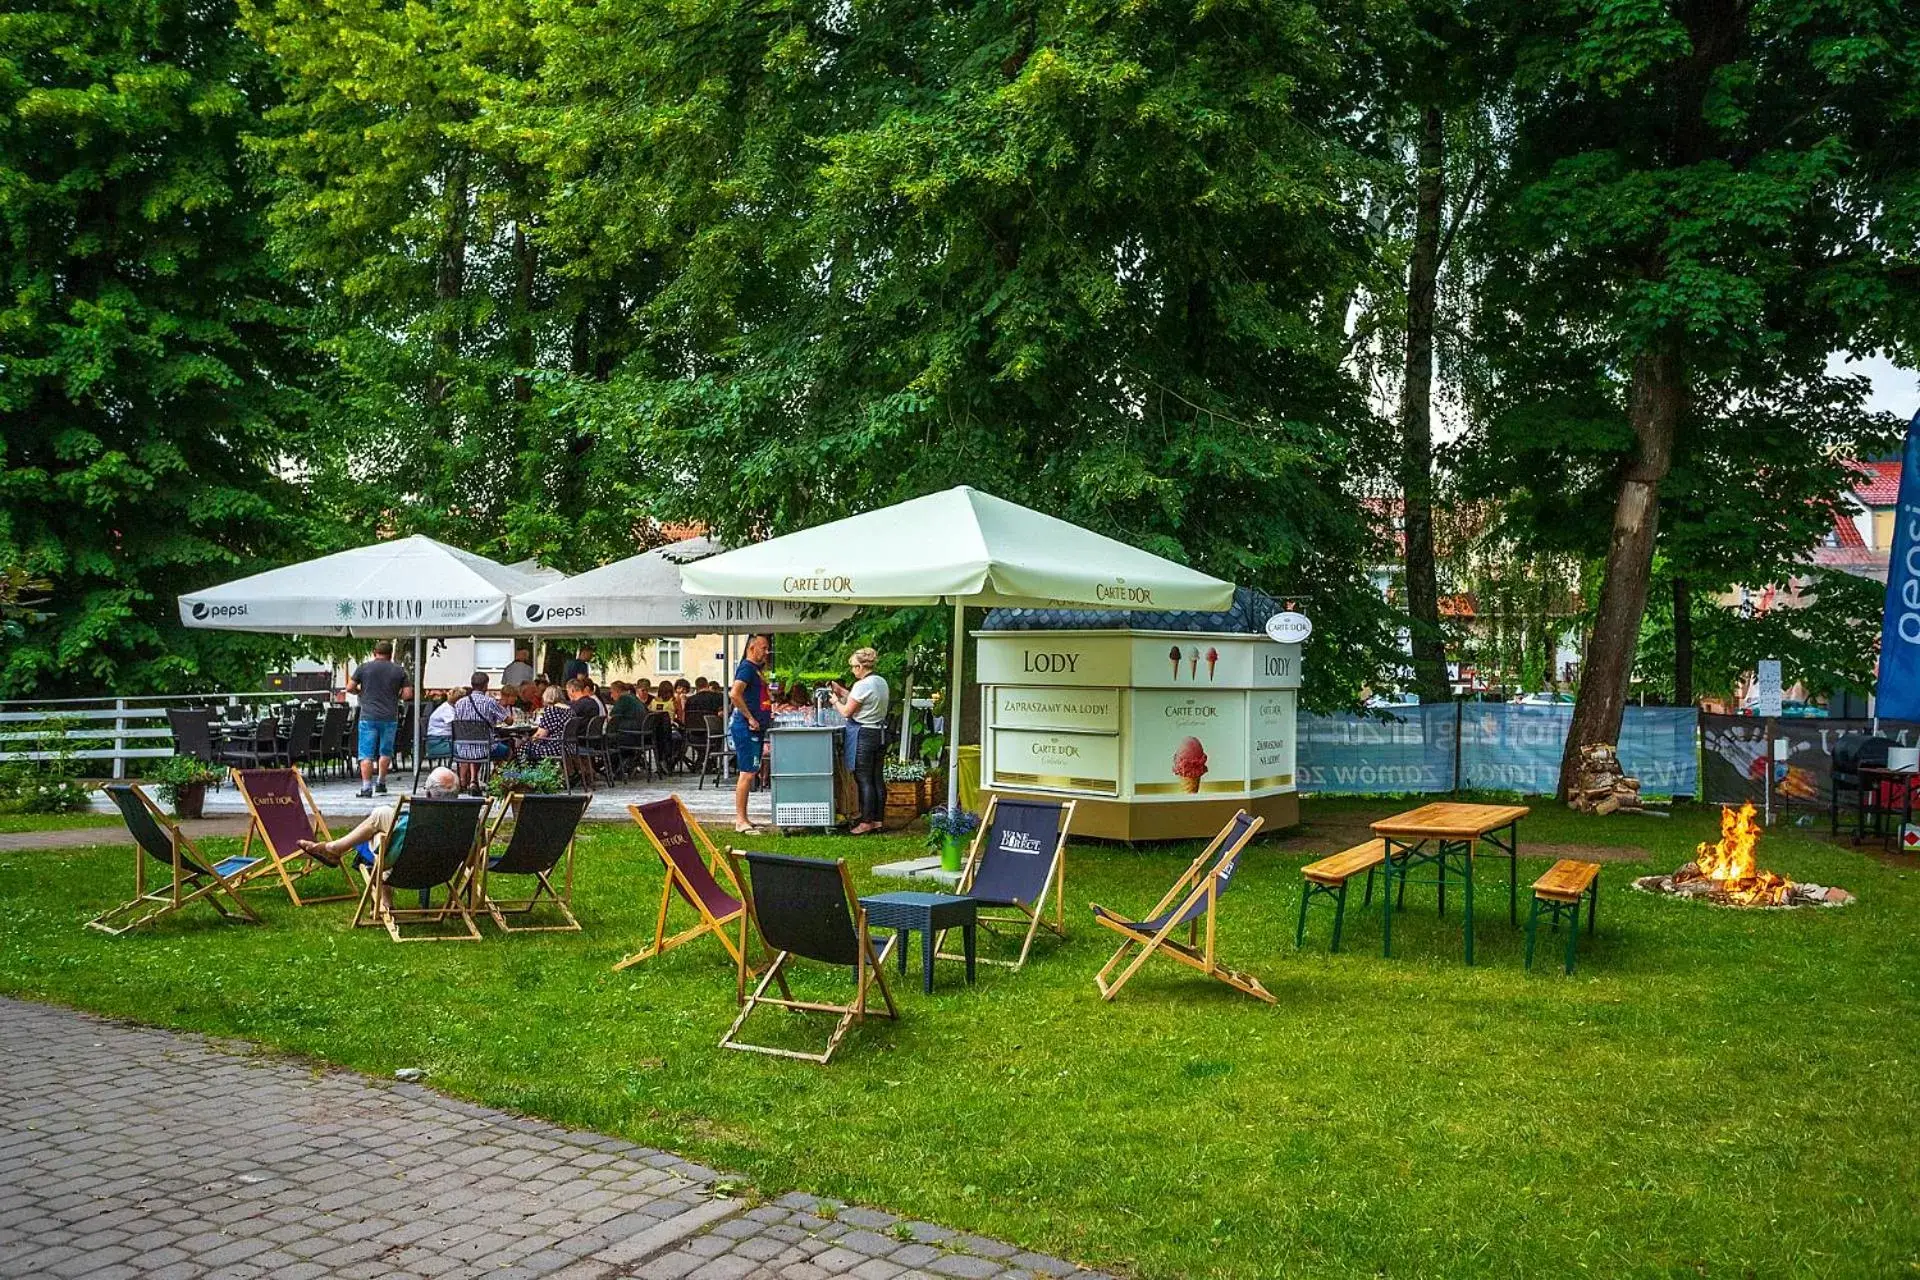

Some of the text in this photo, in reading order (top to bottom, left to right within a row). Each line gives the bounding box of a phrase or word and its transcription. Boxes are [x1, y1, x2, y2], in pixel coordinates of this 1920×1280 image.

[784, 575, 856, 594] CARTE D'OR
[1096, 583, 1126, 601] CARTE
[211, 603, 248, 619] pepsi
[377, 599, 422, 620] BRUNO
[432, 599, 468, 610] HOTEL
[546, 605, 586, 620] pepsi
[726, 600, 774, 621] BRUNO
[1023, 650, 1081, 673] LODY
[1265, 654, 1290, 677] LODY
[1004, 700, 1108, 715] ZAPRASZAMY NA LODY!
[1164, 705, 1193, 718] CARTE
[1031, 743, 1057, 755] CARTE
[1001, 830, 1030, 841] WINE
